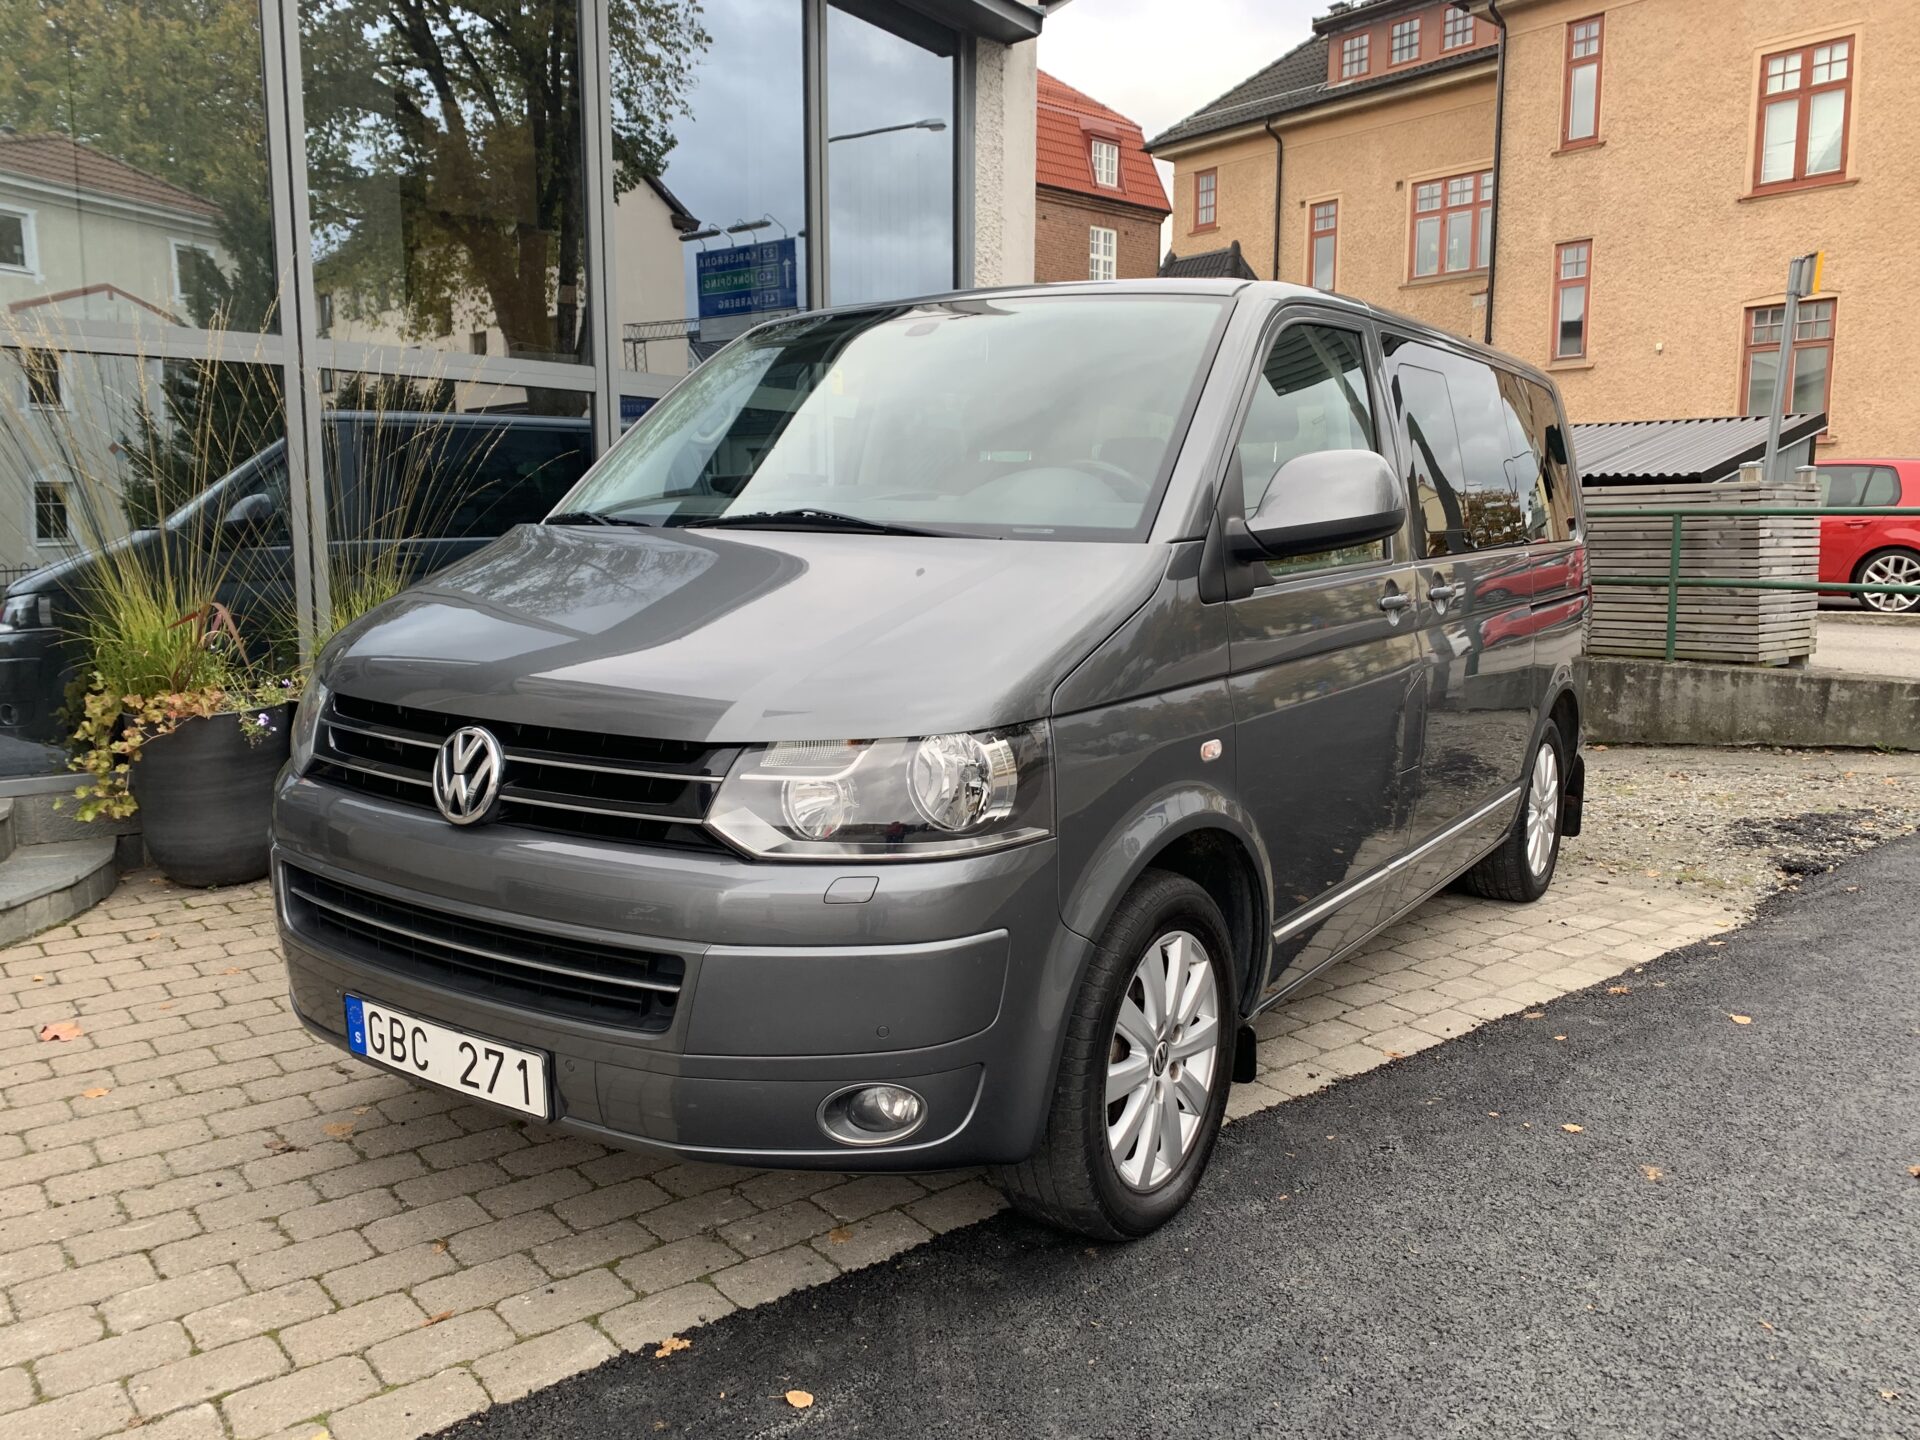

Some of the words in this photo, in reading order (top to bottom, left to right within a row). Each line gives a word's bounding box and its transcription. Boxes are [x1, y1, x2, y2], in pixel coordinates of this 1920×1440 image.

[354, 1031, 362, 1043] S
[368, 1011, 429, 1071] GBC
[458, 1041, 530, 1106] 271
